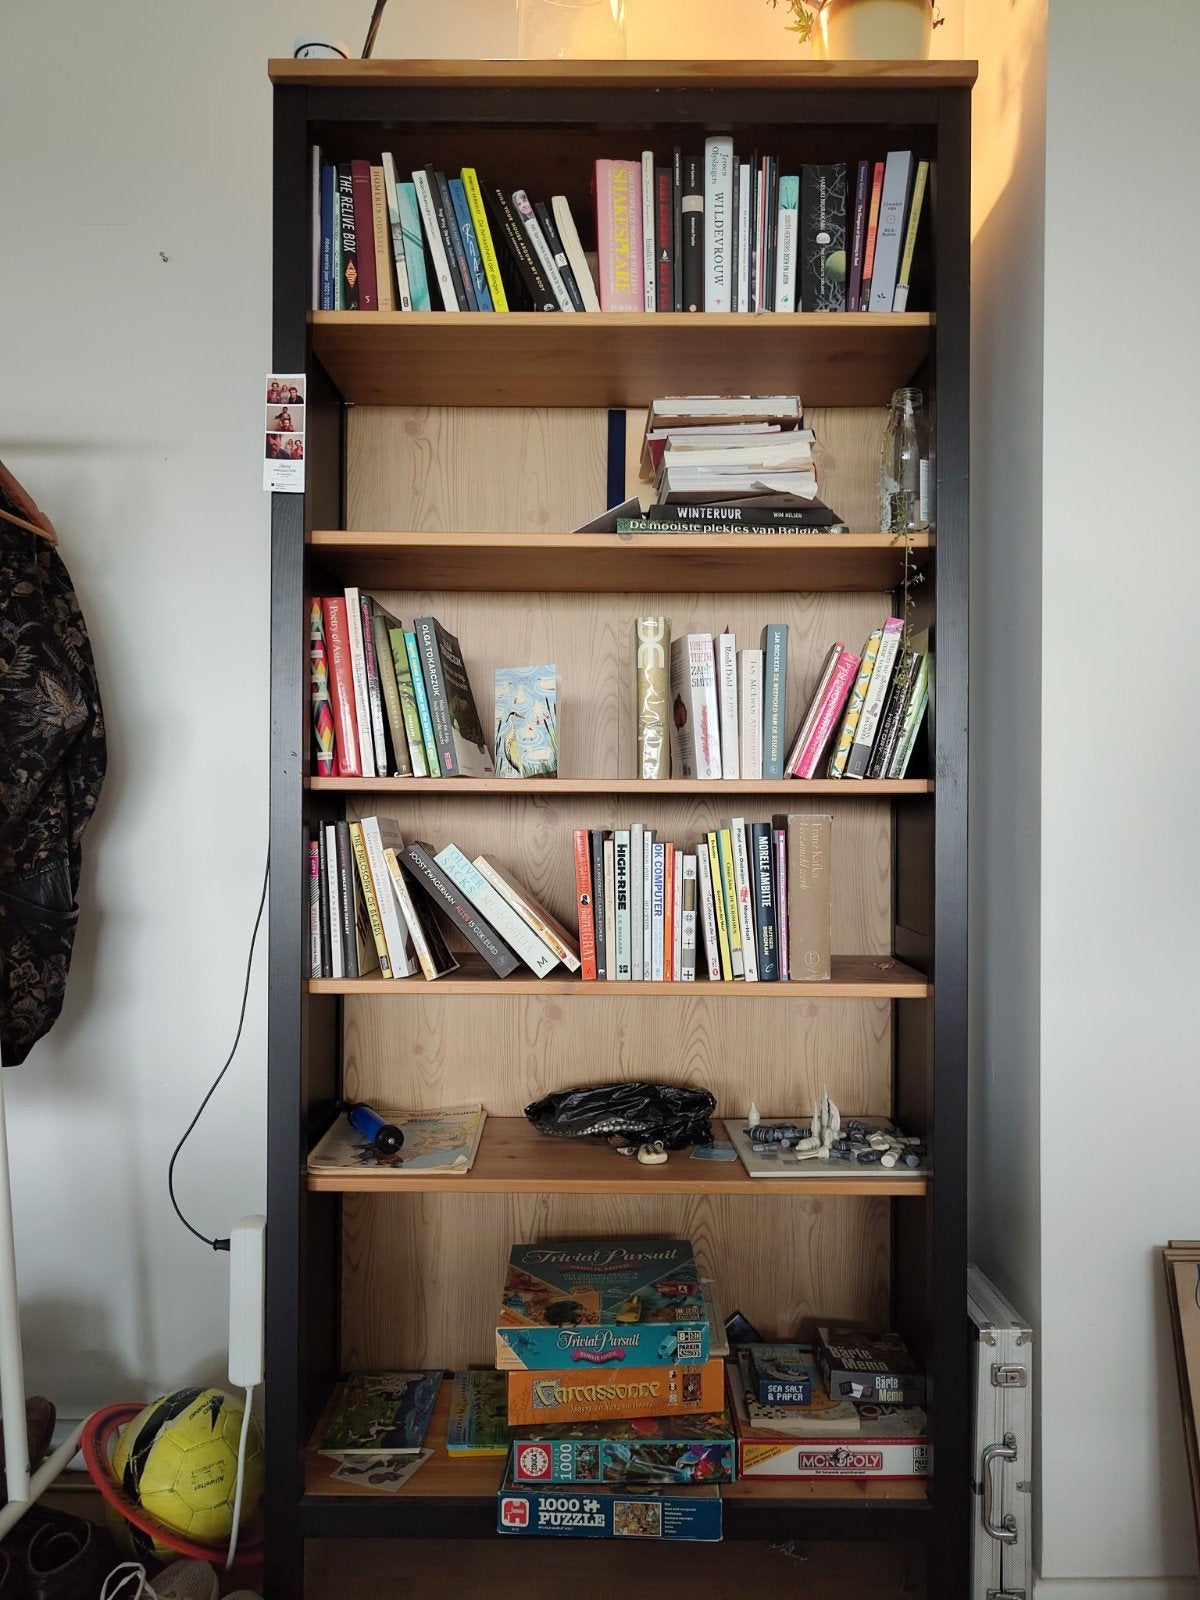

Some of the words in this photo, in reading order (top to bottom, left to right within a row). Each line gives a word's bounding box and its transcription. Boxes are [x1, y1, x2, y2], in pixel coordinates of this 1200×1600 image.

[710, 146, 720, 185] Olyslaegers
[721, 154, 729, 177] Jeroen
[339, 175, 353, 193] THE
[373, 171, 381, 214] HOMERUS
[340, 196, 355, 230] RELIVE
[477, 219, 486, 228] De
[819, 198, 827, 231] MURAKAMI
[343, 232, 356, 253] BOX
[495, 189, 506, 205] BUILD
[504, 206, 513, 222] YOUR
[511, 222, 521, 241] HOUSE
[519, 242, 534, 266] AROUND
[530, 266, 539, 276] MY
[535, 276, 546, 291] BODY
[612, 168, 631, 294] SHAKESPEARE
[713, 192, 724, 286] WILDEVROUW
[479, 228, 493, 262] helaasheid
[853, 234, 861, 252] Smoking
[487, 262, 495, 273] der
[489, 274, 500, 295] dingen
[677, 507, 742, 520] WINTERUUR
[629, 520, 646, 529] De
[649, 520, 701, 532] mooiste
[703, 522, 750, 534] plekjes
[752, 525, 776, 534] van
[328, 605, 340, 632] Poetry
[332, 634, 341, 643] of
[421, 624, 431, 647] OLGA
[332, 645, 343, 664] Asia
[724, 646, 732, 667] Roald
[773, 644, 781, 673] BROKKEN
[425, 647, 441, 697] TOKARCZUK
[725, 669, 733, 687] Dahl
[773, 673, 780, 682] DE
[828, 661, 853, 707] PYNCHON
[421, 712, 429, 722] the
[426, 749, 436, 761] god
[772, 726, 778, 735] DE
[877, 713, 893, 753] HISTORY
[353, 834, 361, 848] THE
[812, 822, 822, 849] Franz
[653, 844, 663, 858] OK
[758, 836, 770, 871] MORELE
[356, 850, 373, 894] PHILOSOPHY
[449, 851, 485, 889] OLIVER
[812, 851, 822, 878] Kafka
[441, 858, 476, 895] SACKS
[617, 843, 628, 911] HIGH-RISE
[653, 861, 663, 917] COMPUTER
[760, 871, 772, 908] AMBITIE
[367, 896, 375, 908] OF
[408, 851, 426, 870] JOOST
[424, 868, 456, 905] ZWAGERMAN
[454, 905, 471, 922] ALLES
[473, 927, 493, 954] GEKLEURD
[369, 909, 381, 937] BEARDS
[742, 904, 751, 941] Music-Hall
[582, 932, 594, 962] GRAY
[521, 1248, 599, 1265] Trivial
[591, 1247, 679, 1266] Pursuit
[556, 1330, 600, 1349] Trivial
[595, 1329, 641, 1351] Pursuit
[828, 1346, 873, 1360] Bärte
[841, 1358, 889, 1371] Memo
[534, 1380, 660, 1406] Carcassonne
[767, 1385, 783, 1393] SEA
[785, 1385, 803, 1393] SALT
[875, 1376, 899, 1389] Bärte
[767, 1393, 774, 1401] &
[776, 1393, 803, 1401] PAPER
[878, 1389, 904, 1402] Memo
[531, 1452, 539, 1471] EDUCA
[559, 1443, 572, 1480] 1000
[537, 1498, 580, 1512] 1000
[537, 1512, 606, 1527] PUZZLE
